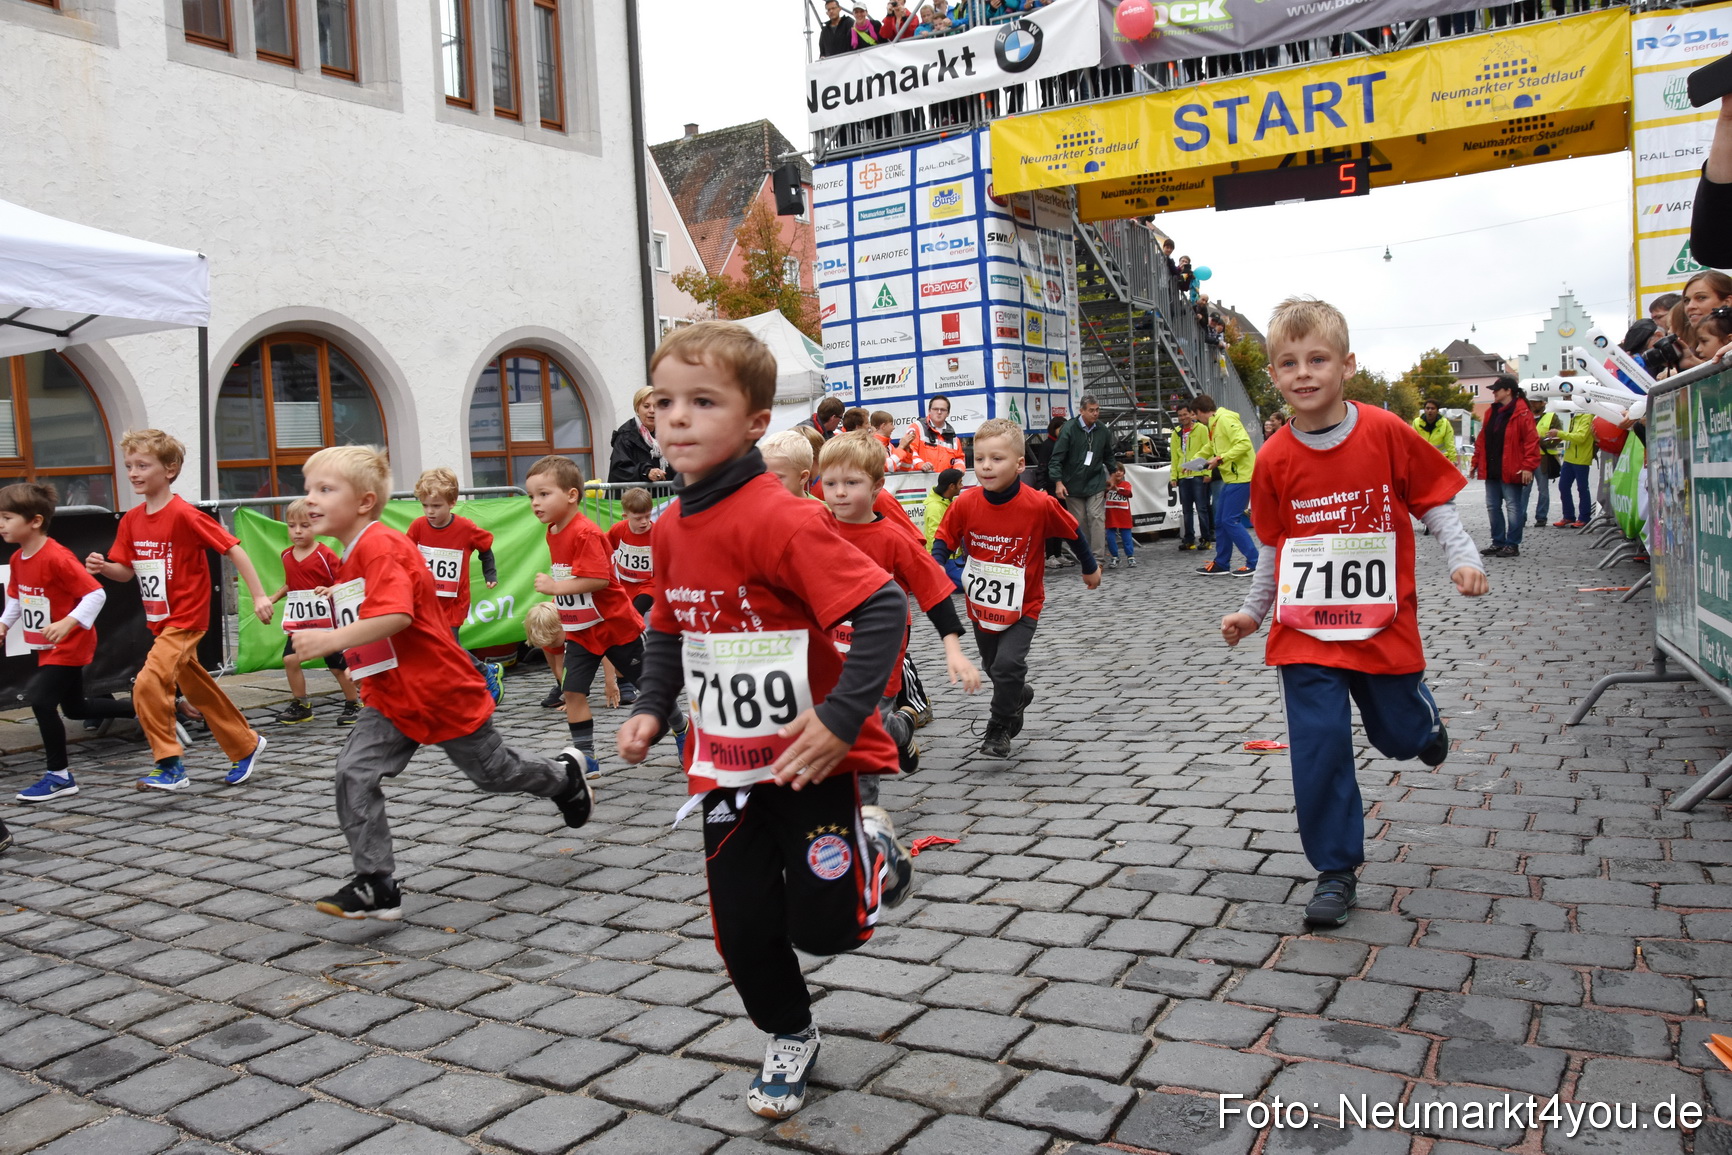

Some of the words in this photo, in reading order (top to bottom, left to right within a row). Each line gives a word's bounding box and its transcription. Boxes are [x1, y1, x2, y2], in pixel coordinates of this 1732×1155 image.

[1163, 27, 1191, 37] smart
[1192, 22, 1235, 34] concepts
[1684, 38, 1729, 53] energie
[807, 46, 976, 114] Neumarkt
[1431, 80, 1515, 102] Neumarkter
[1518, 65, 1587, 89] Stadtlauf
[1664, 75, 1689, 95] RUN
[1172, 71, 1387, 152] START
[1463, 135, 1533, 151] Neumarkter
[1536, 120, 1596, 141] Stadtlauf
[1020, 148, 1085, 165] Neumarkter
[1087, 139, 1140, 156] Stadtlauf
[1639, 146, 1704, 162] RAIL.ONE
[884, 164, 903, 173] CODE
[918, 159, 957, 173] RAIL.ONE
[884, 170, 906, 180] CLINIC
[1339, 162, 1357, 195] 5
[813, 179, 844, 191] ARIOTEC
[1101, 186, 1157, 200] Neumarkter
[1159, 178, 1206, 193] Stadtlauf
[815, 224, 831, 232] ONE
[871, 248, 909, 262] VARIOTEC
[949, 246, 975, 256] energie
[823, 267, 847, 277] energie
[823, 340, 850, 351] ARIOTEC
[860, 336, 898, 347] RAIL.ONE
[863, 373, 896, 387] swn
[934, 379, 975, 389] Lammsbräu
[940, 374, 969, 382] Neumarkter
[832, 390, 854, 398] energie
[1530, 382, 1550, 392] BM
[893, 416, 916, 426] IOTEC
[1710, 402, 1732, 433] Event-L
[1290, 490, 1361, 510] Neumarkter
[1295, 506, 1347, 525] Stadtlauf
[1698, 492, 1725, 537] Mehr
[1333, 537, 1387, 550] BOCK
[428, 559, 458, 579] 163
[983, 565, 1019, 576] BOCK
[1699, 548, 1714, 595] für
[1715, 554, 1730, 602] Ihr
[140, 575, 160, 598] 52
[1292, 559, 1387, 600] 7160
[967, 573, 1015, 608] 7231
[1388, 594, 1394, 602] K
[288, 600, 327, 619] 7016
[983, 609, 1006, 623] Leon
[23, 608, 45, 630] 02
[1314, 610, 1363, 626] Moritz
[714, 637, 793, 658] BOCK
[1700, 631, 1716, 665] Miet
[1715, 646, 1723, 669] &
[691, 670, 798, 729] 7189
[710, 742, 774, 769] Philipp
[783, 1044, 801, 1052] LICO
